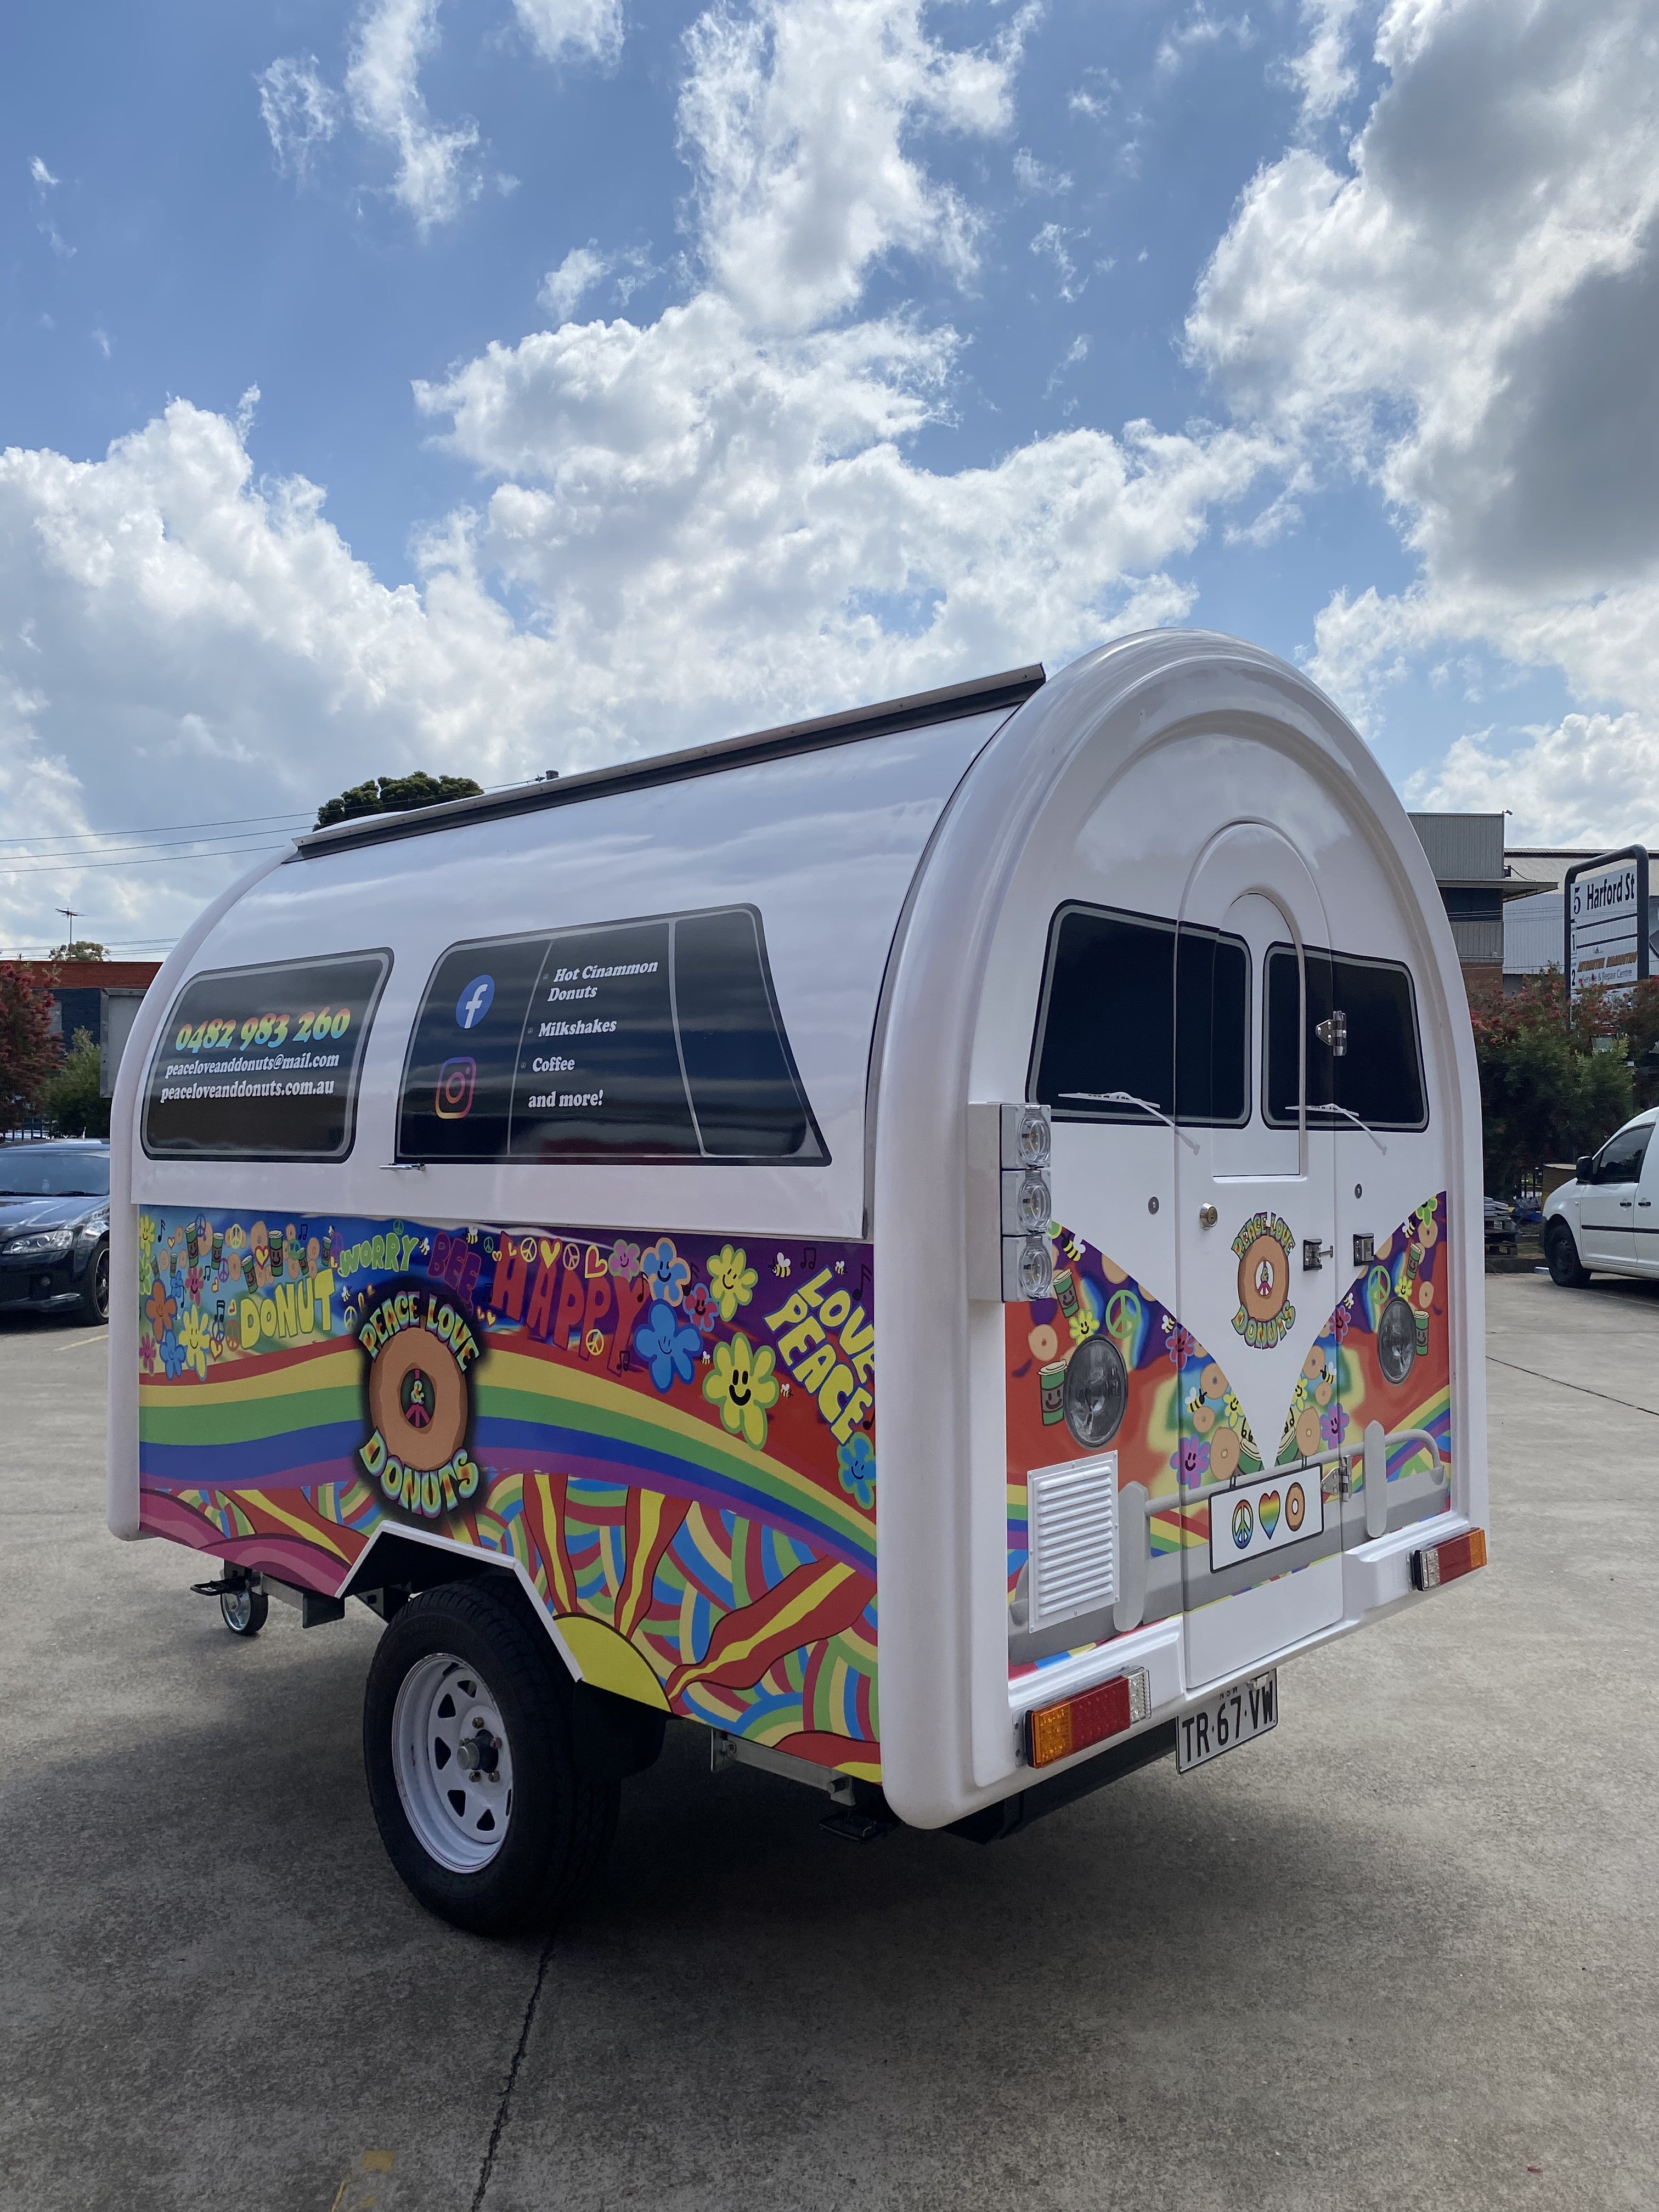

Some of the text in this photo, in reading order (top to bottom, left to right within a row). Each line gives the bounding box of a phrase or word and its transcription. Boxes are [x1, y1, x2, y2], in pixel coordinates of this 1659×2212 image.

[1573, 872, 1635, 915] 5 Harford St
[1572, 934, 1575, 951] 1
[553, 961, 658, 983] Hot Cinammon
[1571, 969, 1576, 986] 2
[1617, 969, 1633, 979] Centre
[548, 985, 598, 1002] Donuts
[175, 1006, 351, 1053] 0482 983 260
[538, 1019, 617, 1037] Milkshakes
[165, 1052, 340, 1079] peaceloveanddonuts@mail.com
[532, 1056, 575, 1072] Coffee
[160, 1079, 335, 1103] peaceloveanddonuts.com.au
[528, 1089, 603, 1108] and more!
[1231, 1211, 1296, 1262] PEACE LOVE
[240, 1231, 651, 1376] DONUT WORRY BEE HAPPY
[358, 1290, 481, 1373] PEACE LOVE
[1231, 1299, 1296, 1350] DONUTS
[763, 1293, 873, 1446] PEACE
[410, 1379, 425, 1405] &
[359, 1426, 479, 1519] DONUTS
